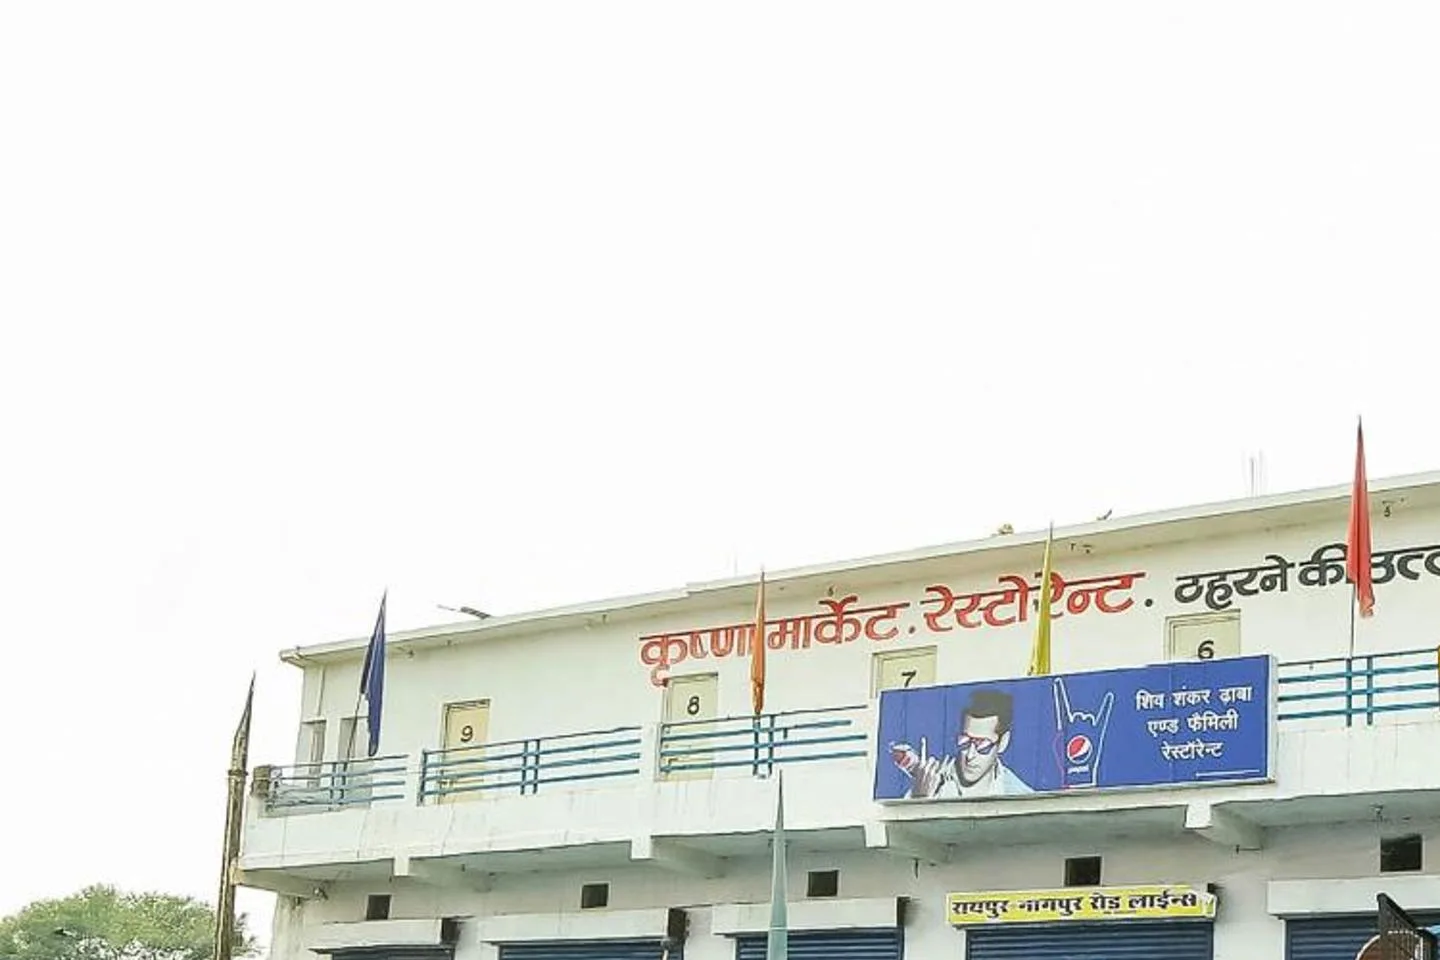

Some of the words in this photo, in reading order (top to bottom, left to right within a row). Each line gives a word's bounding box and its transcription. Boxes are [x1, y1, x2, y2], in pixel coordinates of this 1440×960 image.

[1174, 555, 1294, 611] ठहरने
[1198, 640, 1215, 660] 6
[901, 670, 917, 688] 7
[686, 695, 701, 716] 8
[1136, 689, 1165, 711] शिव
[1172, 685, 1211, 707] शंकर
[1187, 708, 1239, 732] फैमिली
[459, 725, 473, 743] 9
[952, 900, 1010, 919] रायपुर
[1016, 895, 1083, 917] नागपुर
